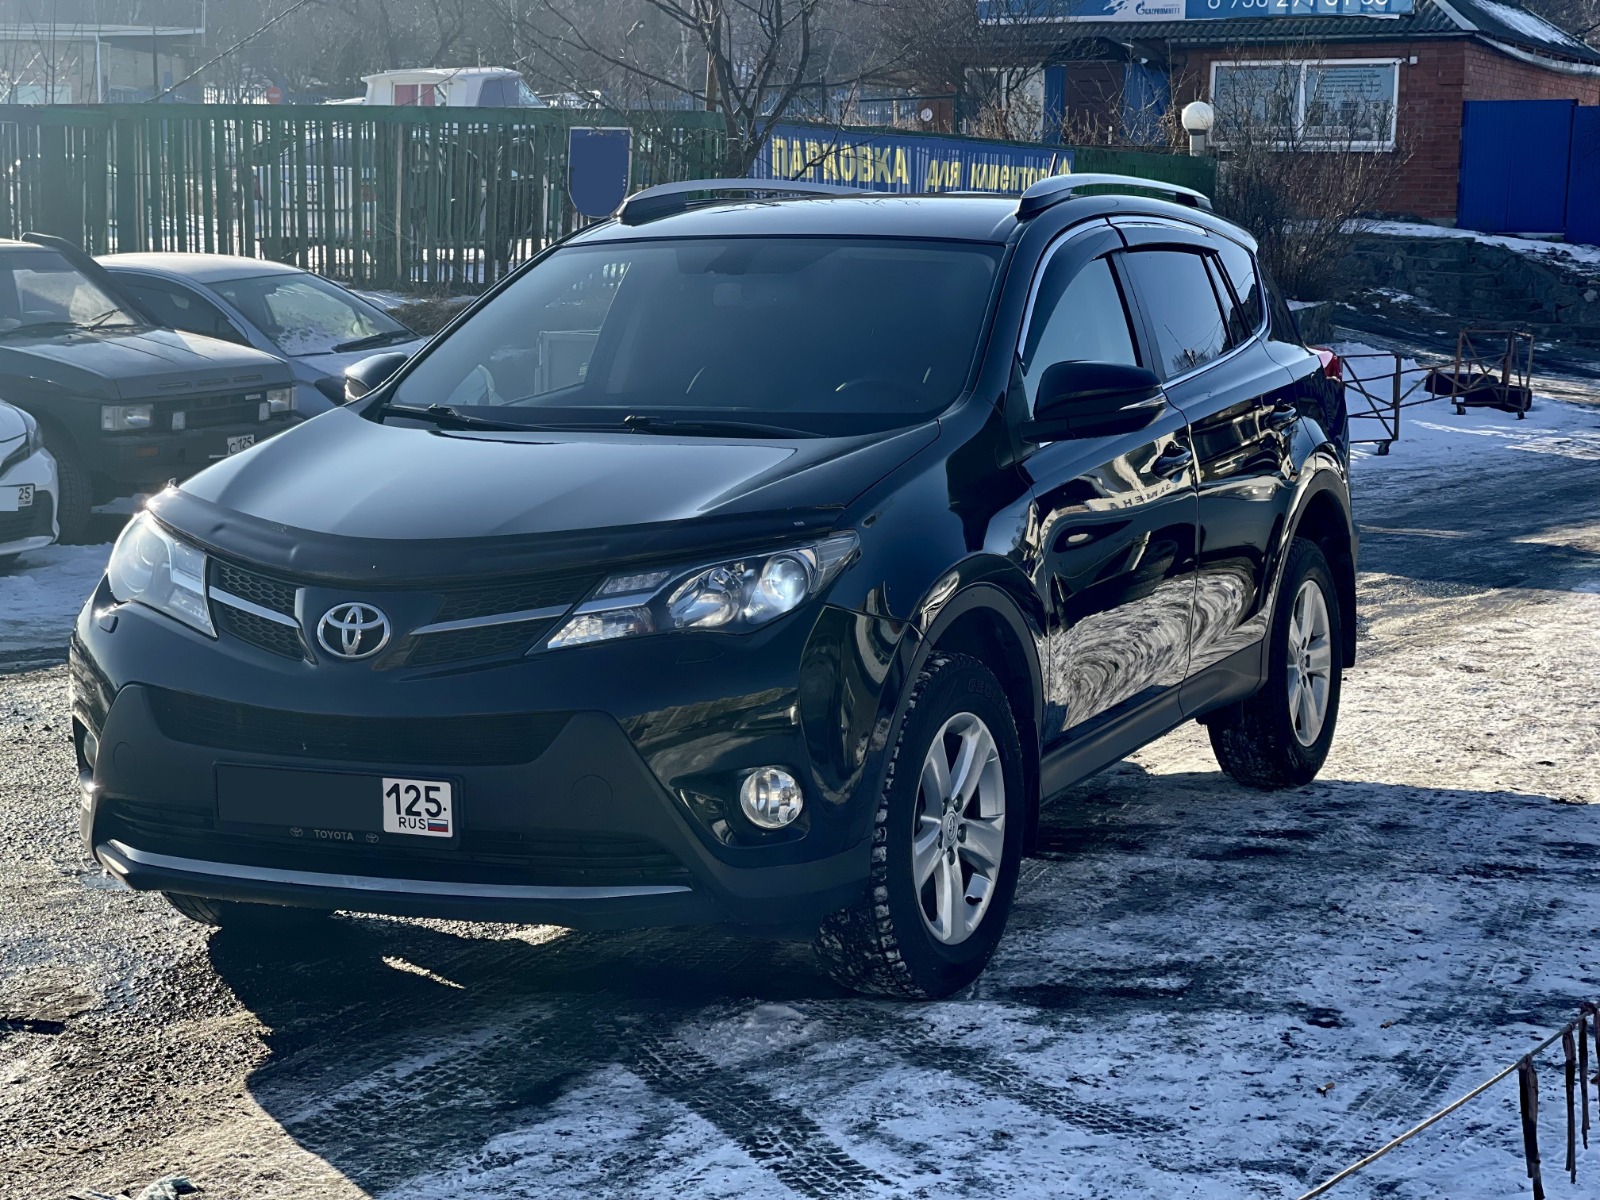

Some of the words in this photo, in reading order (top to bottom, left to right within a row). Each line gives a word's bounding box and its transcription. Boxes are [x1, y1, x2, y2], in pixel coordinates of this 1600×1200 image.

[772, 137, 909, 185] ПАРКОВКА
[385, 783, 442, 818] 125
[314, 829, 354, 841] TOYOTA
[398, 816, 427, 830] RUS
